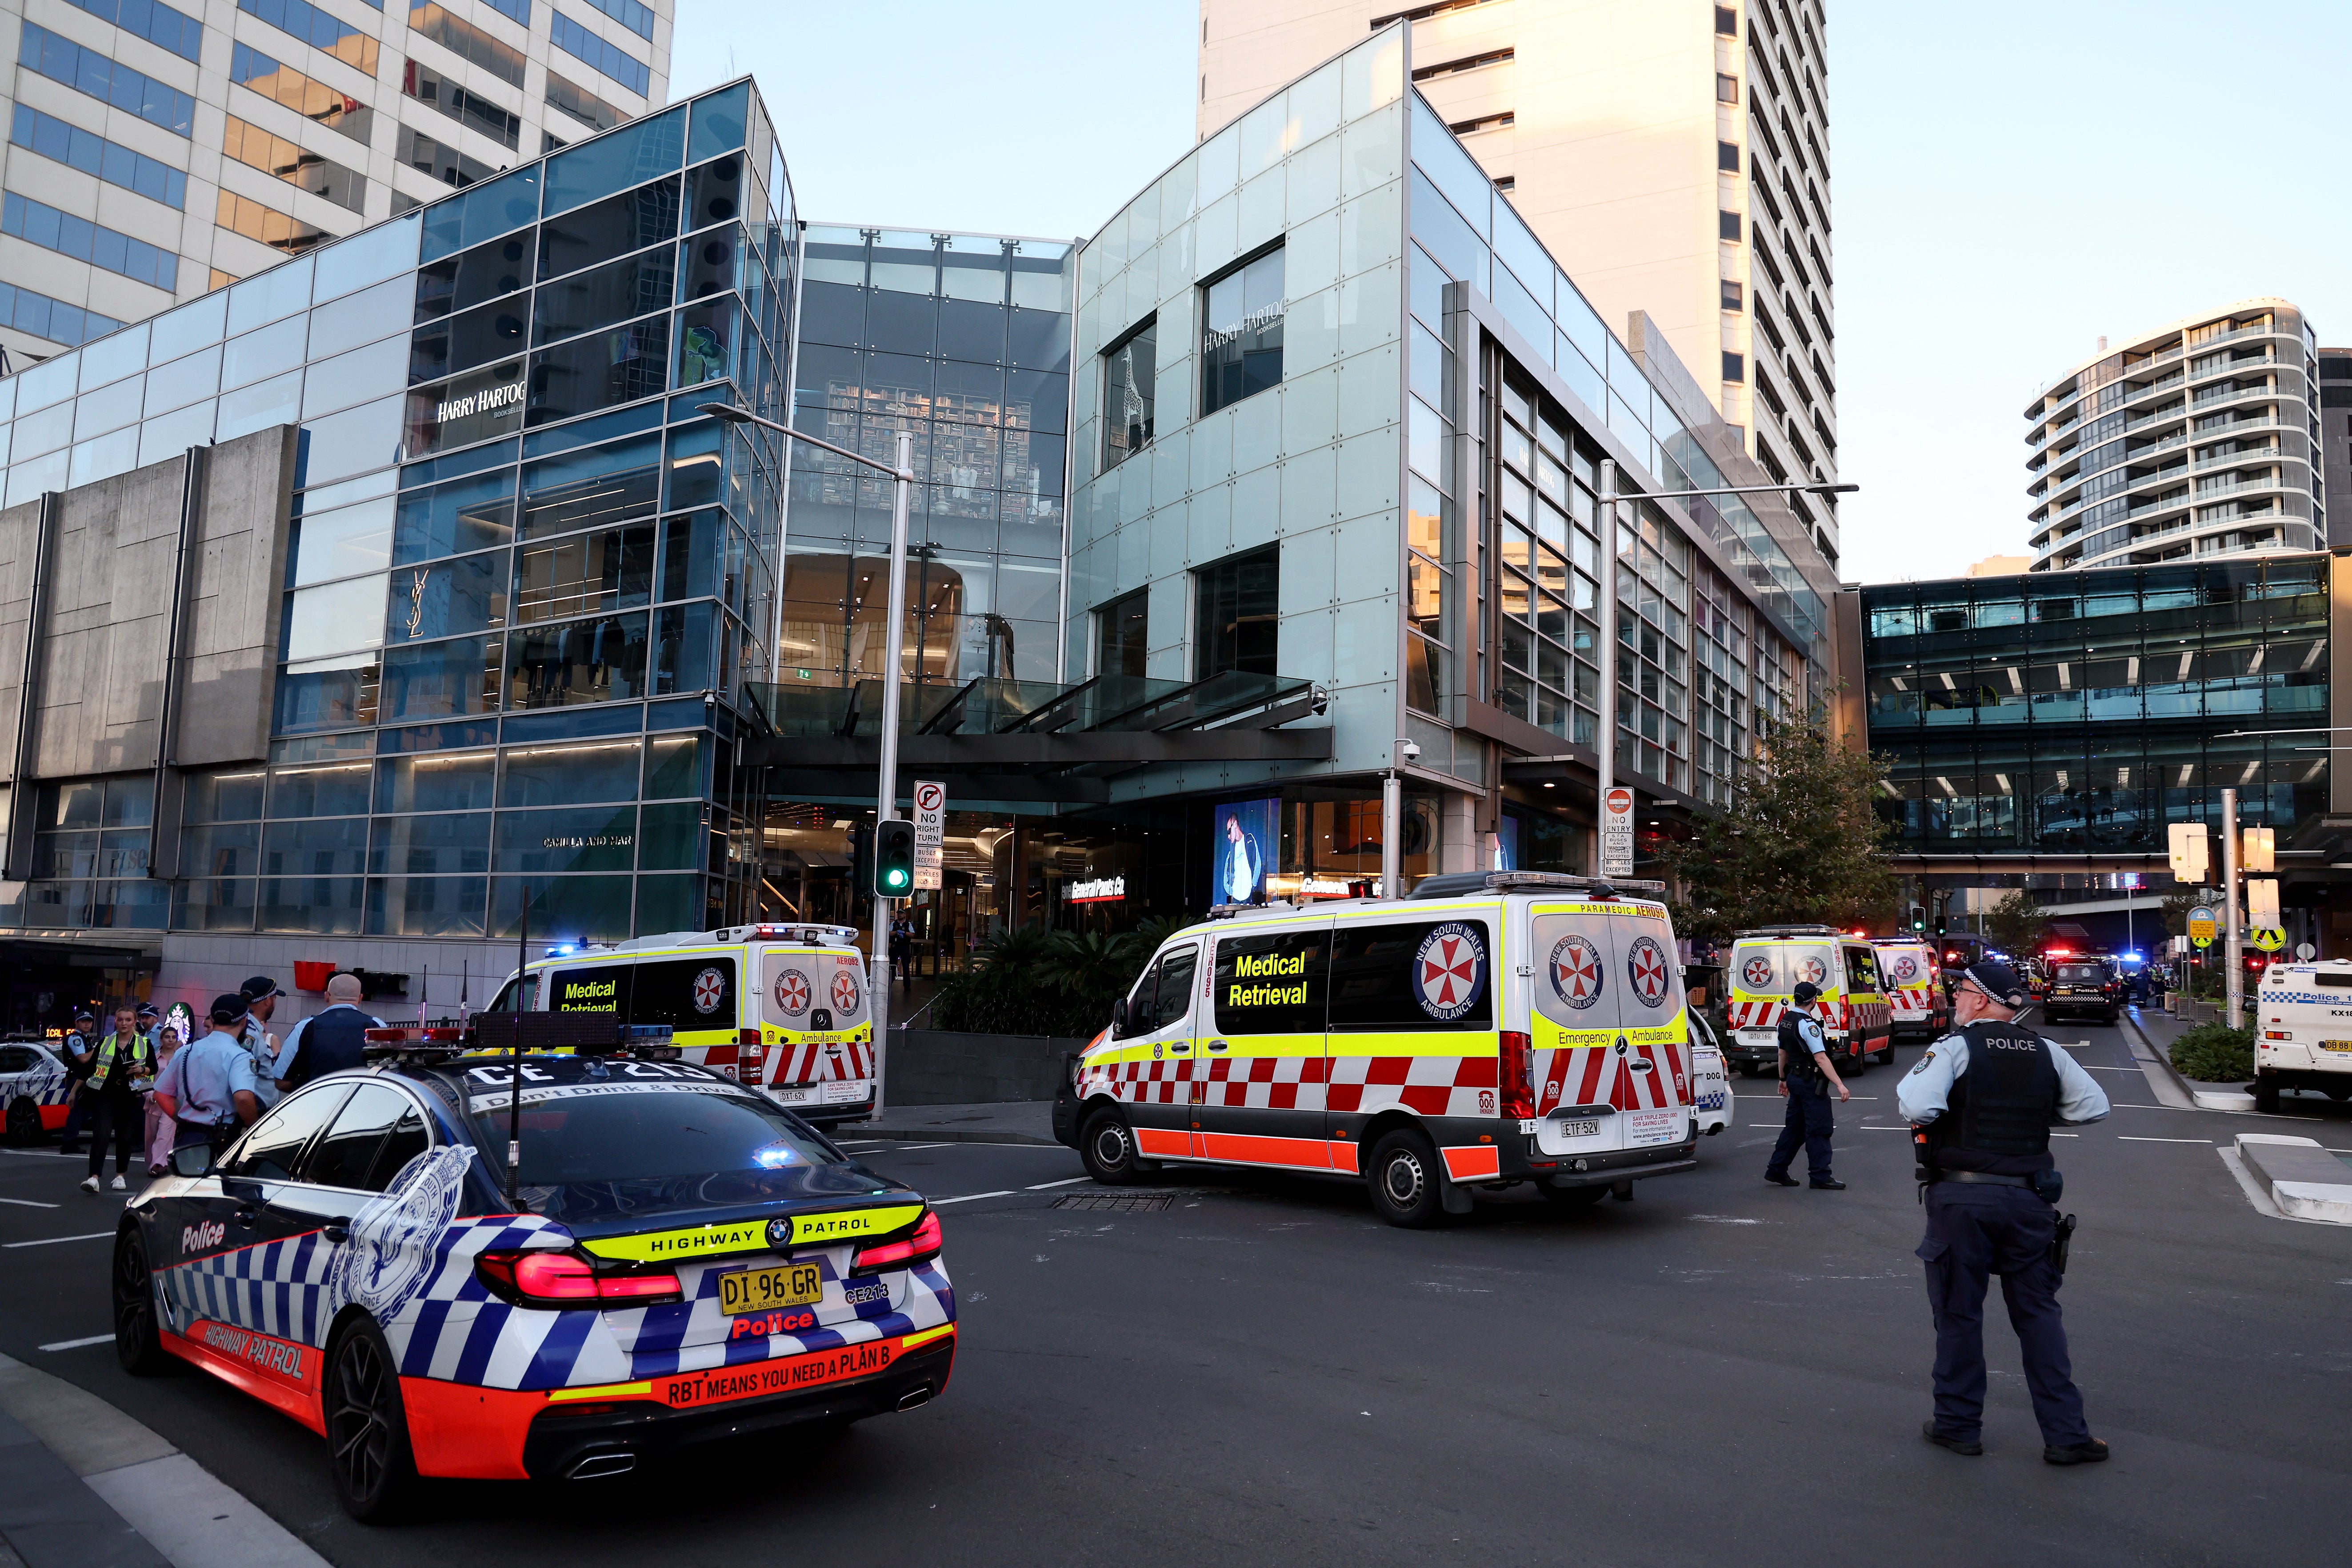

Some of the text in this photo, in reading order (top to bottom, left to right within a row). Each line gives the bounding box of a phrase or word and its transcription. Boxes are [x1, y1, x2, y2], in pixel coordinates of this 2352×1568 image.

[1257, 317, 1284, 335] BOOKSELLE
[1204, 320, 1240, 353] HARRY
[438, 395, 476, 423] HARRY
[921, 813, 936, 823] NO
[543, 837, 581, 847] CAMILLA
[586, 836, 606, 845] AND
[1072, 879, 1097, 899] General
[1096, 878, 1115, 897] Pants
[1114, 876, 1124, 896] Co.
[1580, 904, 1631, 914] PARAMEDIC
[1416, 923, 1484, 961] NEW SOUTH WALES
[1551, 936, 1600, 966] NEW SOUTH WALES
[1636, 938, 1652, 948] SOUTH
[1653, 942, 1667, 968] WALES
[1236, 952, 1305, 977] Medical
[693, 968, 725, 986] NEW SOUTH WALES
[798, 972, 810, 989] WALES
[849, 973, 858, 991] WALES
[565, 980, 616, 999] Medical
[1229, 981, 1307, 1006] Retrieval
[561, 1000, 616, 1012] Retrieval
[1560, 992, 1598, 1008] AMBULANCE
[1636, 991, 1666, 1007] AMBULANCE
[695, 1003, 720, 1014] AMBULANCE
[781, 1005, 808, 1016] AMBULANCE
[836, 1005, 857, 1016] AMBULANCE
[1421, 997, 1473, 1020] AMBULANCE
[1780, 1021, 1792, 1030] POLICE
[801, 1033, 841, 1043] Ambulance
[1559, 1030, 1673, 1046] Emergency Ambulance
[1986, 1038, 2037, 1051] POLICE
[468, 1061, 716, 1085] CE 213
[724, 1072, 736, 1080] 000
[1706, 1072, 1720, 1080] DOG
[486, 1090, 566, 1107] Don't
[570, 1085, 644, 1095] Drink
[673, 1085, 736, 1095] Drive
[1547, 1086, 1559, 1094] 000
[1479, 1098, 1494, 1108] 000
[1633, 1131, 1679, 1139] www.ambulance.nsw.gov.au
[182, 1220, 225, 1254] Police
[413, 1207, 437, 1252] WALES
[651, 1218, 871, 1252] HIGHWAY PATROL
[352, 1245, 364, 1290] POLICE
[360, 1294, 381, 1306] FORCE
[757, 1300, 782, 1309] SOUTH
[785, 1296, 808, 1304] WALES
[845, 1283, 889, 1305] CE213
[732, 1312, 813, 1339] Police
[203, 1324, 303, 1380] HIGHWAY PATROL
[668, 1346, 890, 1404] RBT MEANS YOU NEED A PLAN B
